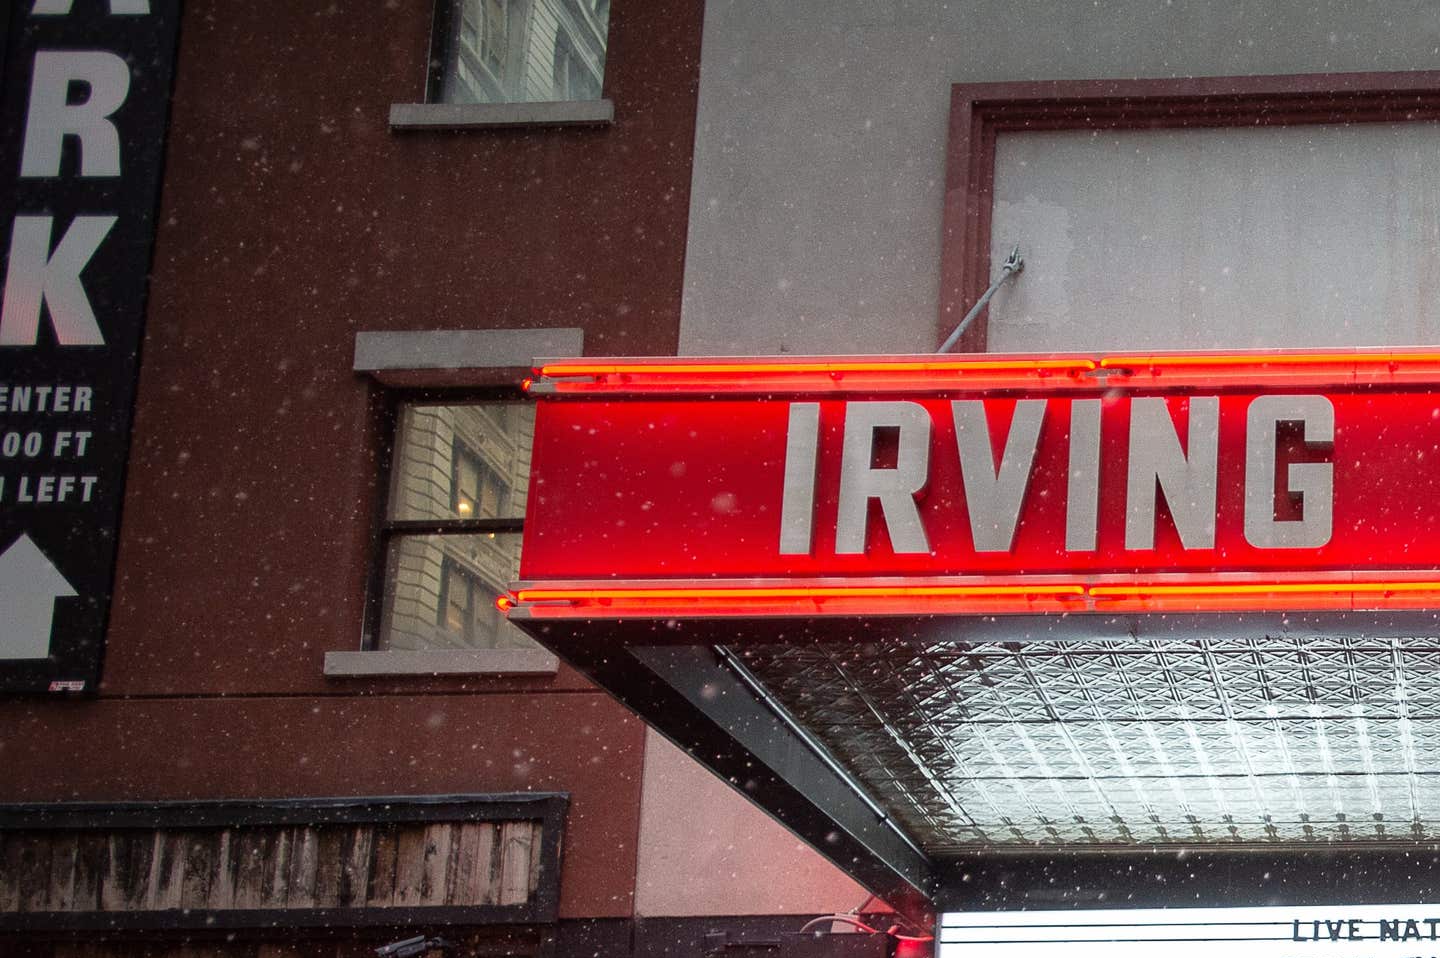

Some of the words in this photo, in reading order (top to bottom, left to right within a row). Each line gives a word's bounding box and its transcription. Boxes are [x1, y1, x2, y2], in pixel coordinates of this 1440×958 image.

[54, 431, 93, 457] FT
[778, 394, 1335, 556] IRVING
[18, 476, 98, 502] LEFT
[1293, 918, 1363, 942] LIVE
